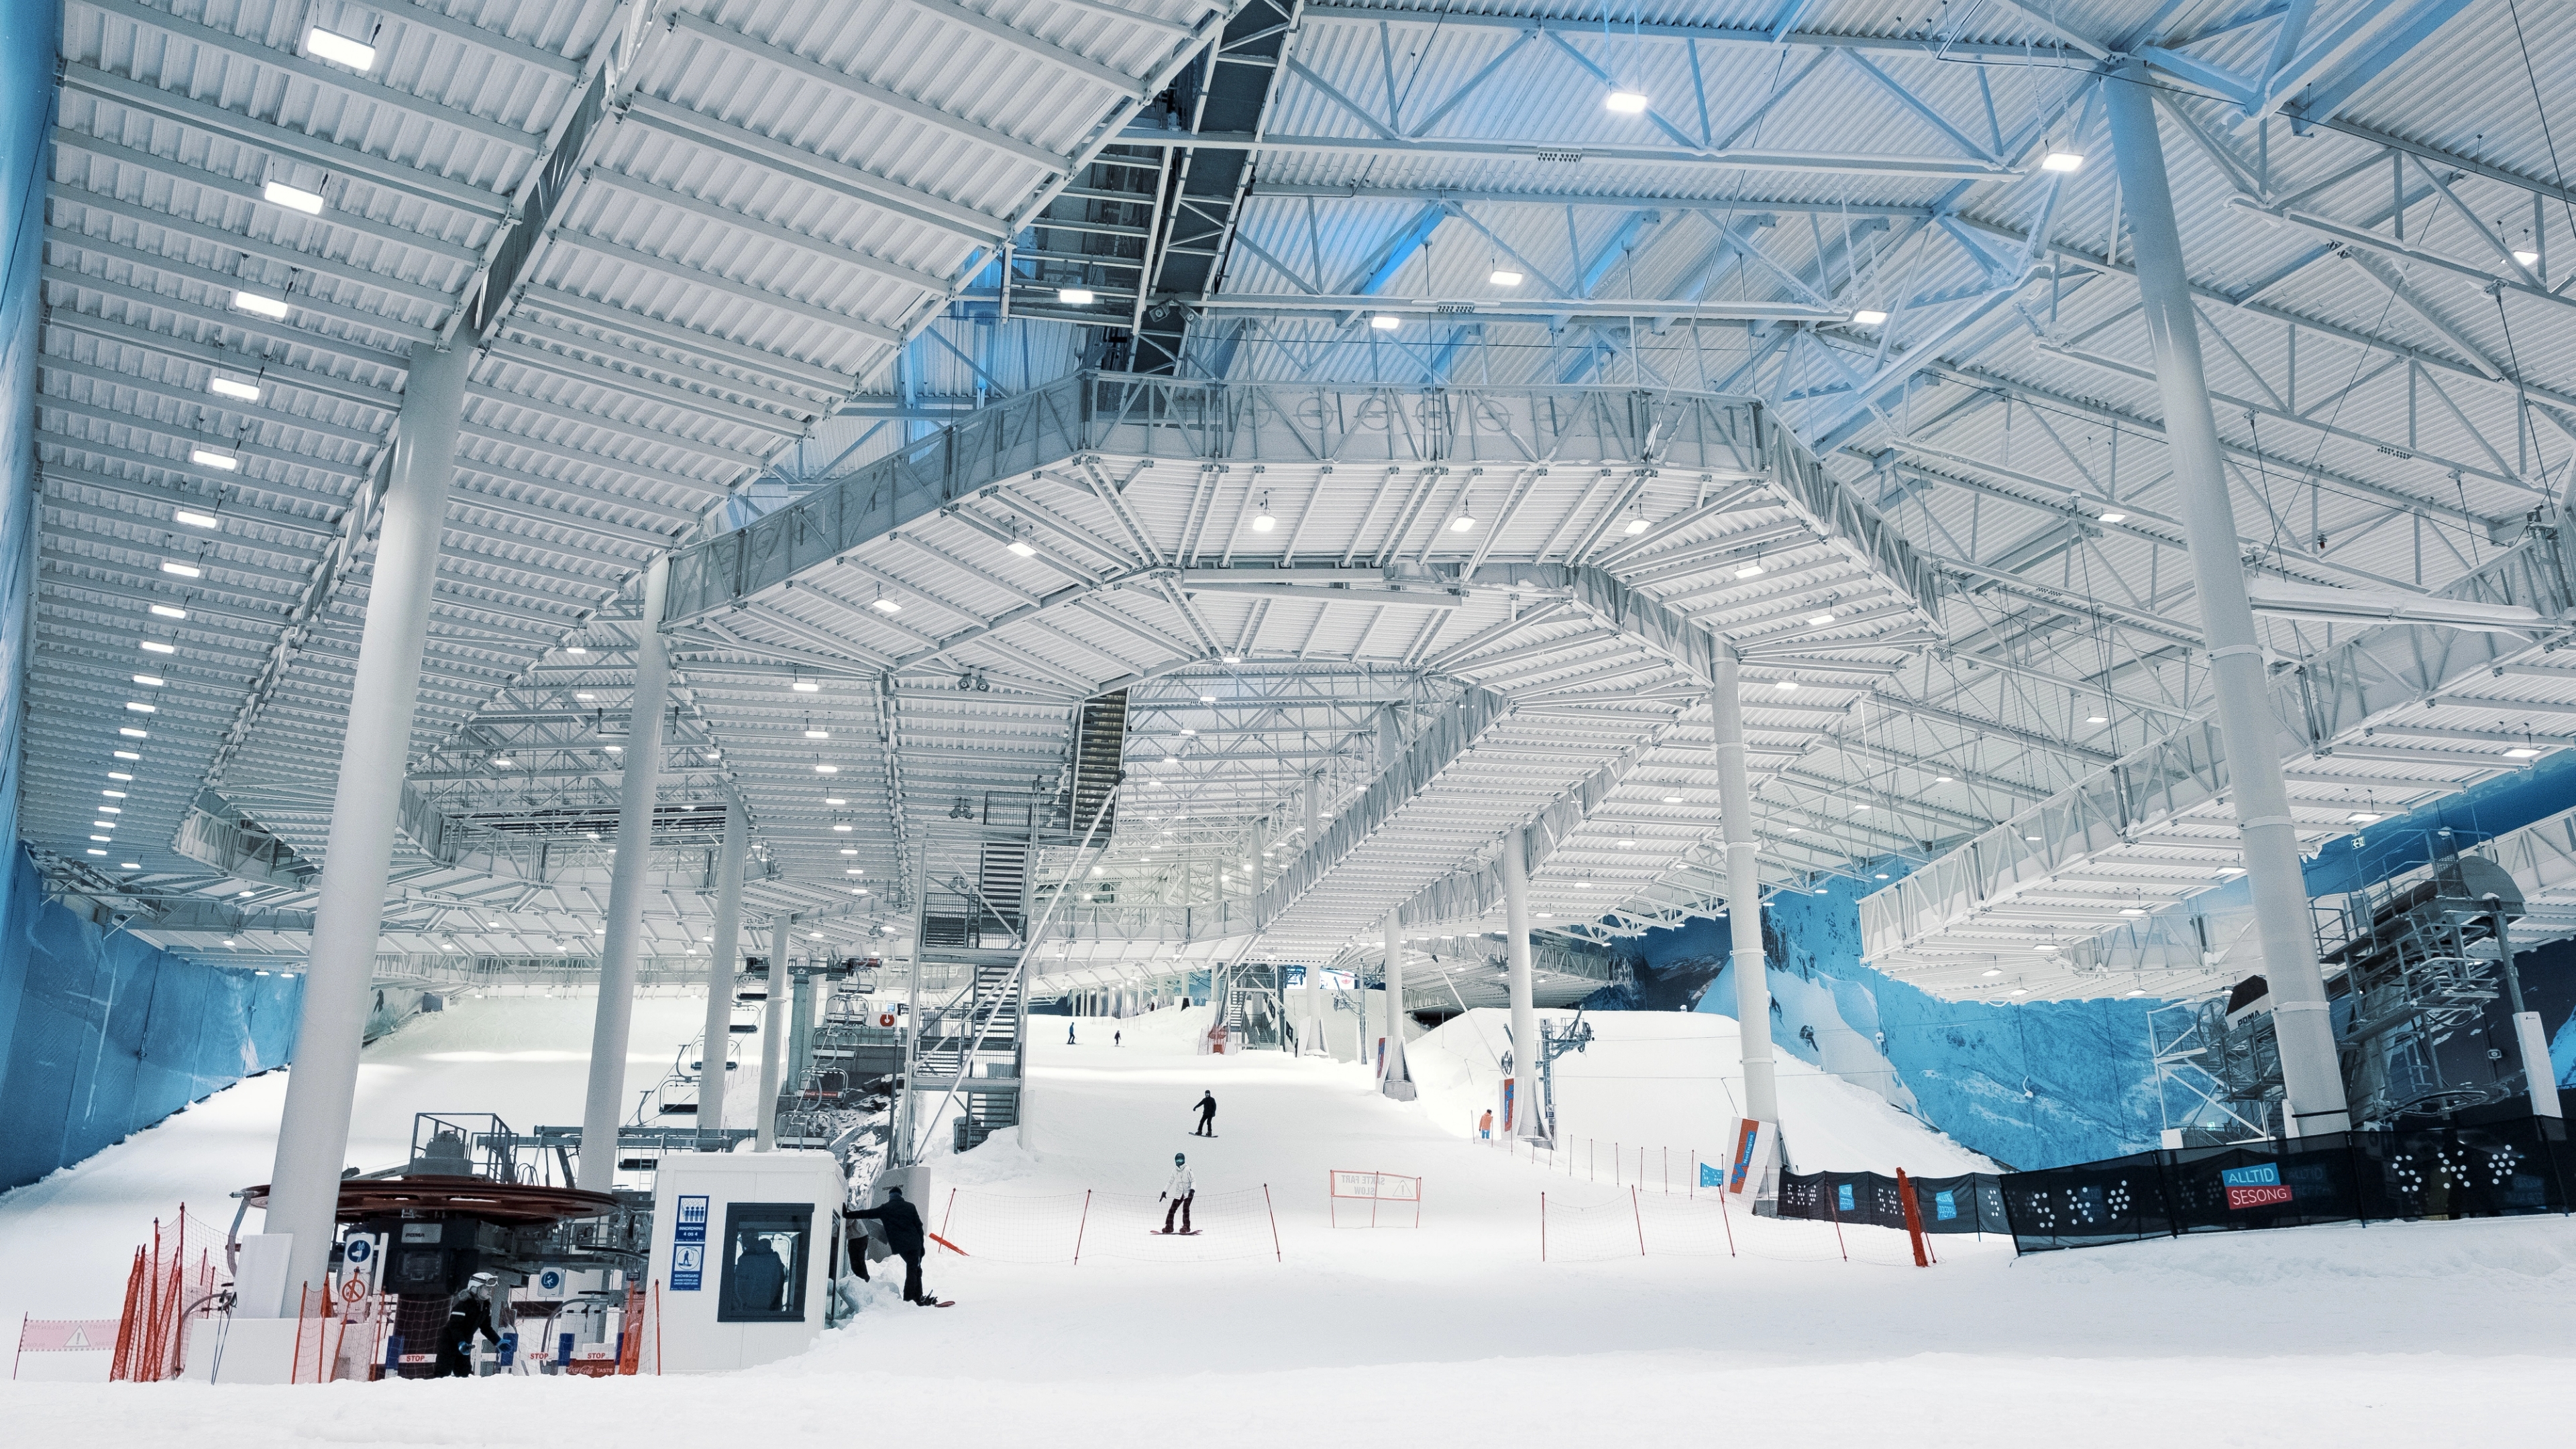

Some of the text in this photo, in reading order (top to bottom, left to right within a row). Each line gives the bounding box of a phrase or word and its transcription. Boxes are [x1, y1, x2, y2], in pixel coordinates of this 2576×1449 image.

[2237, 1010, 2261, 1026] POMA
[2229, 1167, 2275, 1183] ALLTID
[2231, 1188, 2287, 1205] SESONG
